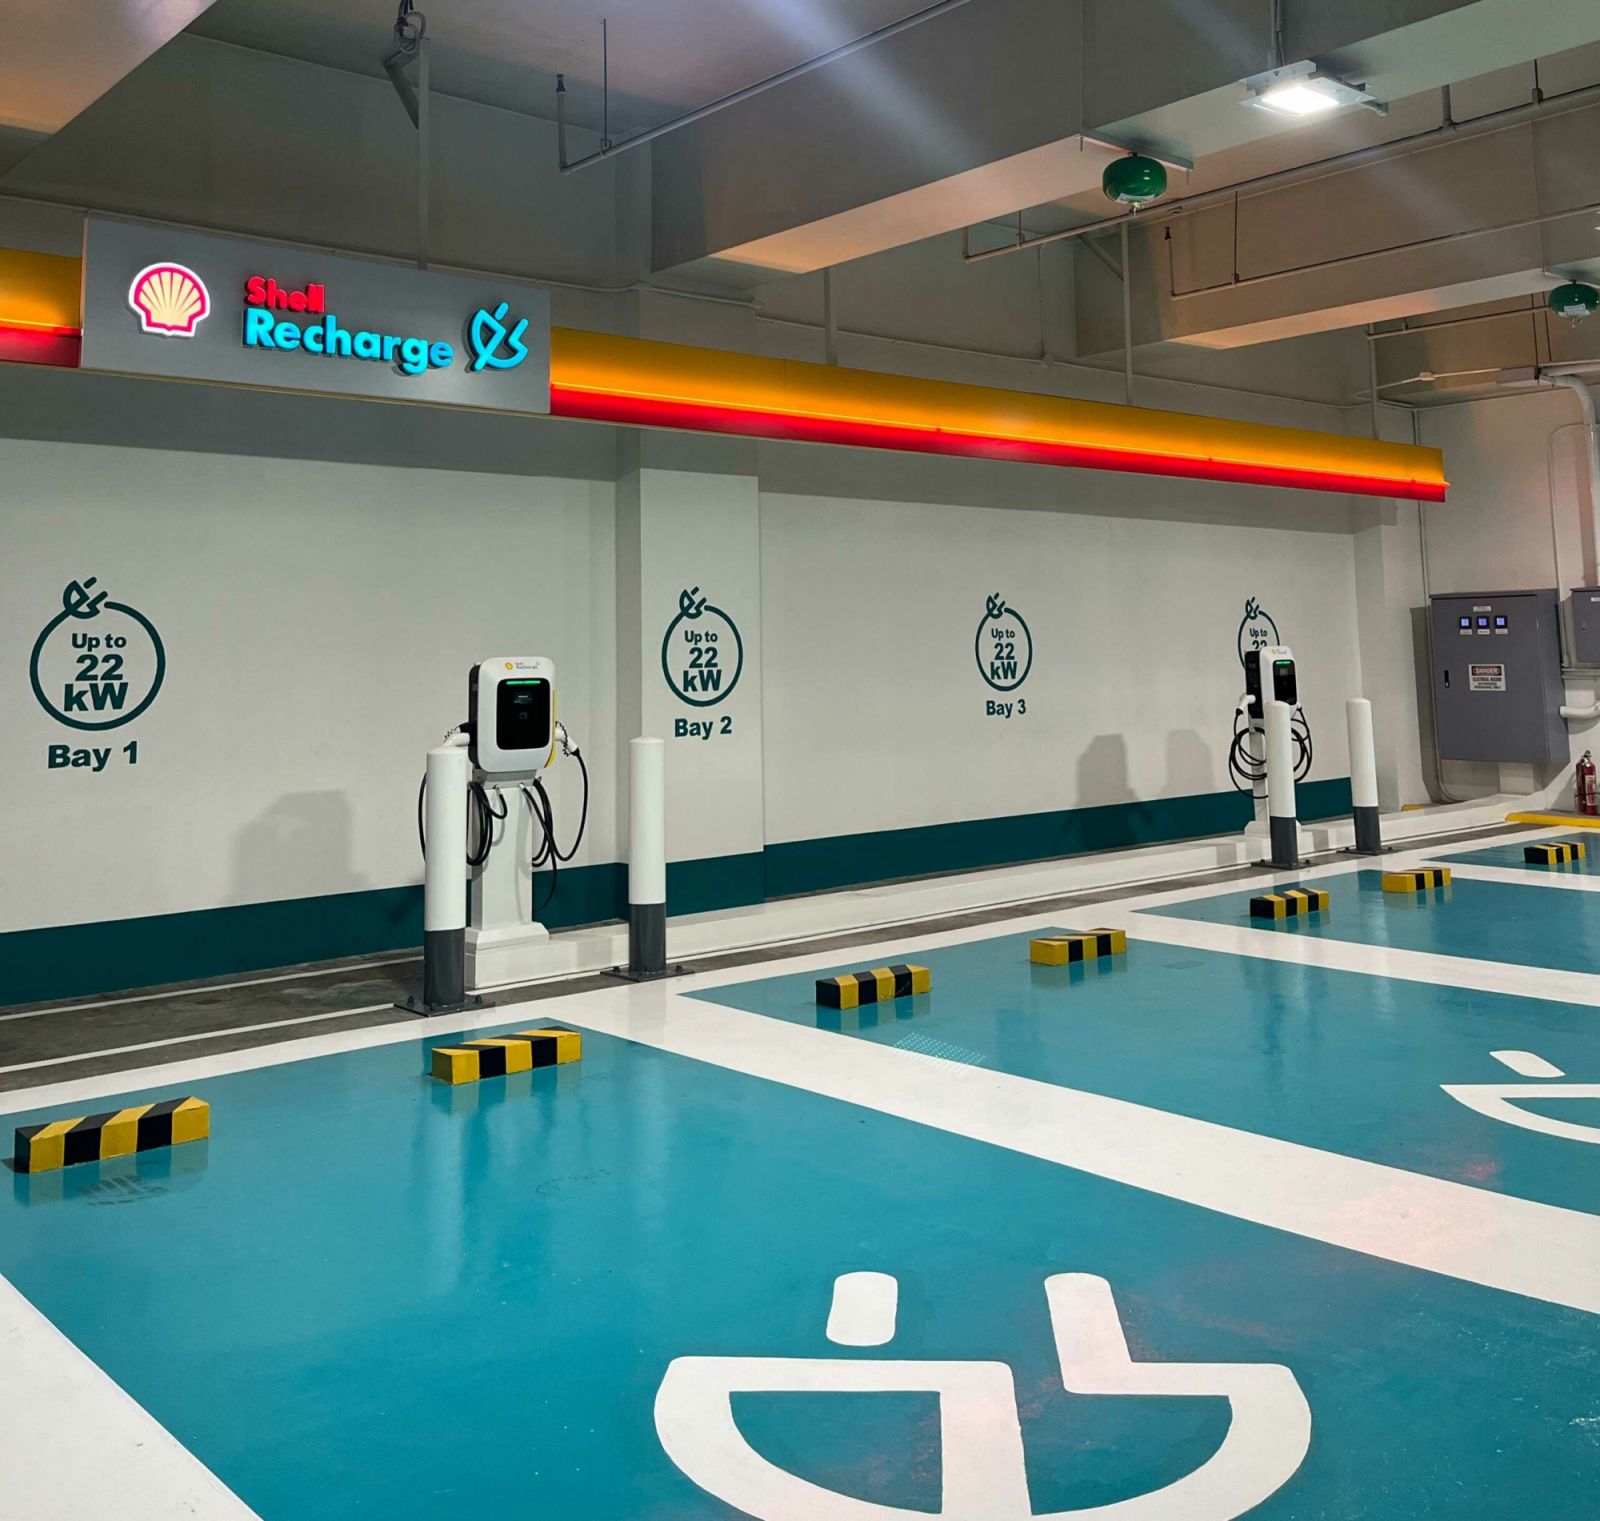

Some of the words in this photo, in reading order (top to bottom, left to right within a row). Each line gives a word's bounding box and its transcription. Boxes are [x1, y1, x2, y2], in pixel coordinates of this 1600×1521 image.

[245, 275, 325, 314] Shell
[244, 307, 454, 375] Recharge
[71, 633, 100, 652] Up
[104, 634, 127, 649] to
[684, 630, 702, 645] Up
[704, 631, 718, 643] to
[990, 628, 1004, 641] Up
[1005, 629, 1016, 639] to
[1249, 628, 1259, 639] Up
[1260, 629, 1268, 638] to
[688, 647, 718, 669] 22
[994, 642, 1015, 661] 22
[75, 654, 124, 682] 22
[990, 661, 1018, 680] kW
[683, 669, 722, 692] kW
[63, 682, 129, 712] kW
[985, 700, 1013, 719] Bay
[1017, 699, 1027, 715] 3
[674, 719, 713, 740] Bay
[720, 716, 732, 735] 2
[47, 744, 112, 772] Bay
[123, 740, 138, 764] 1
